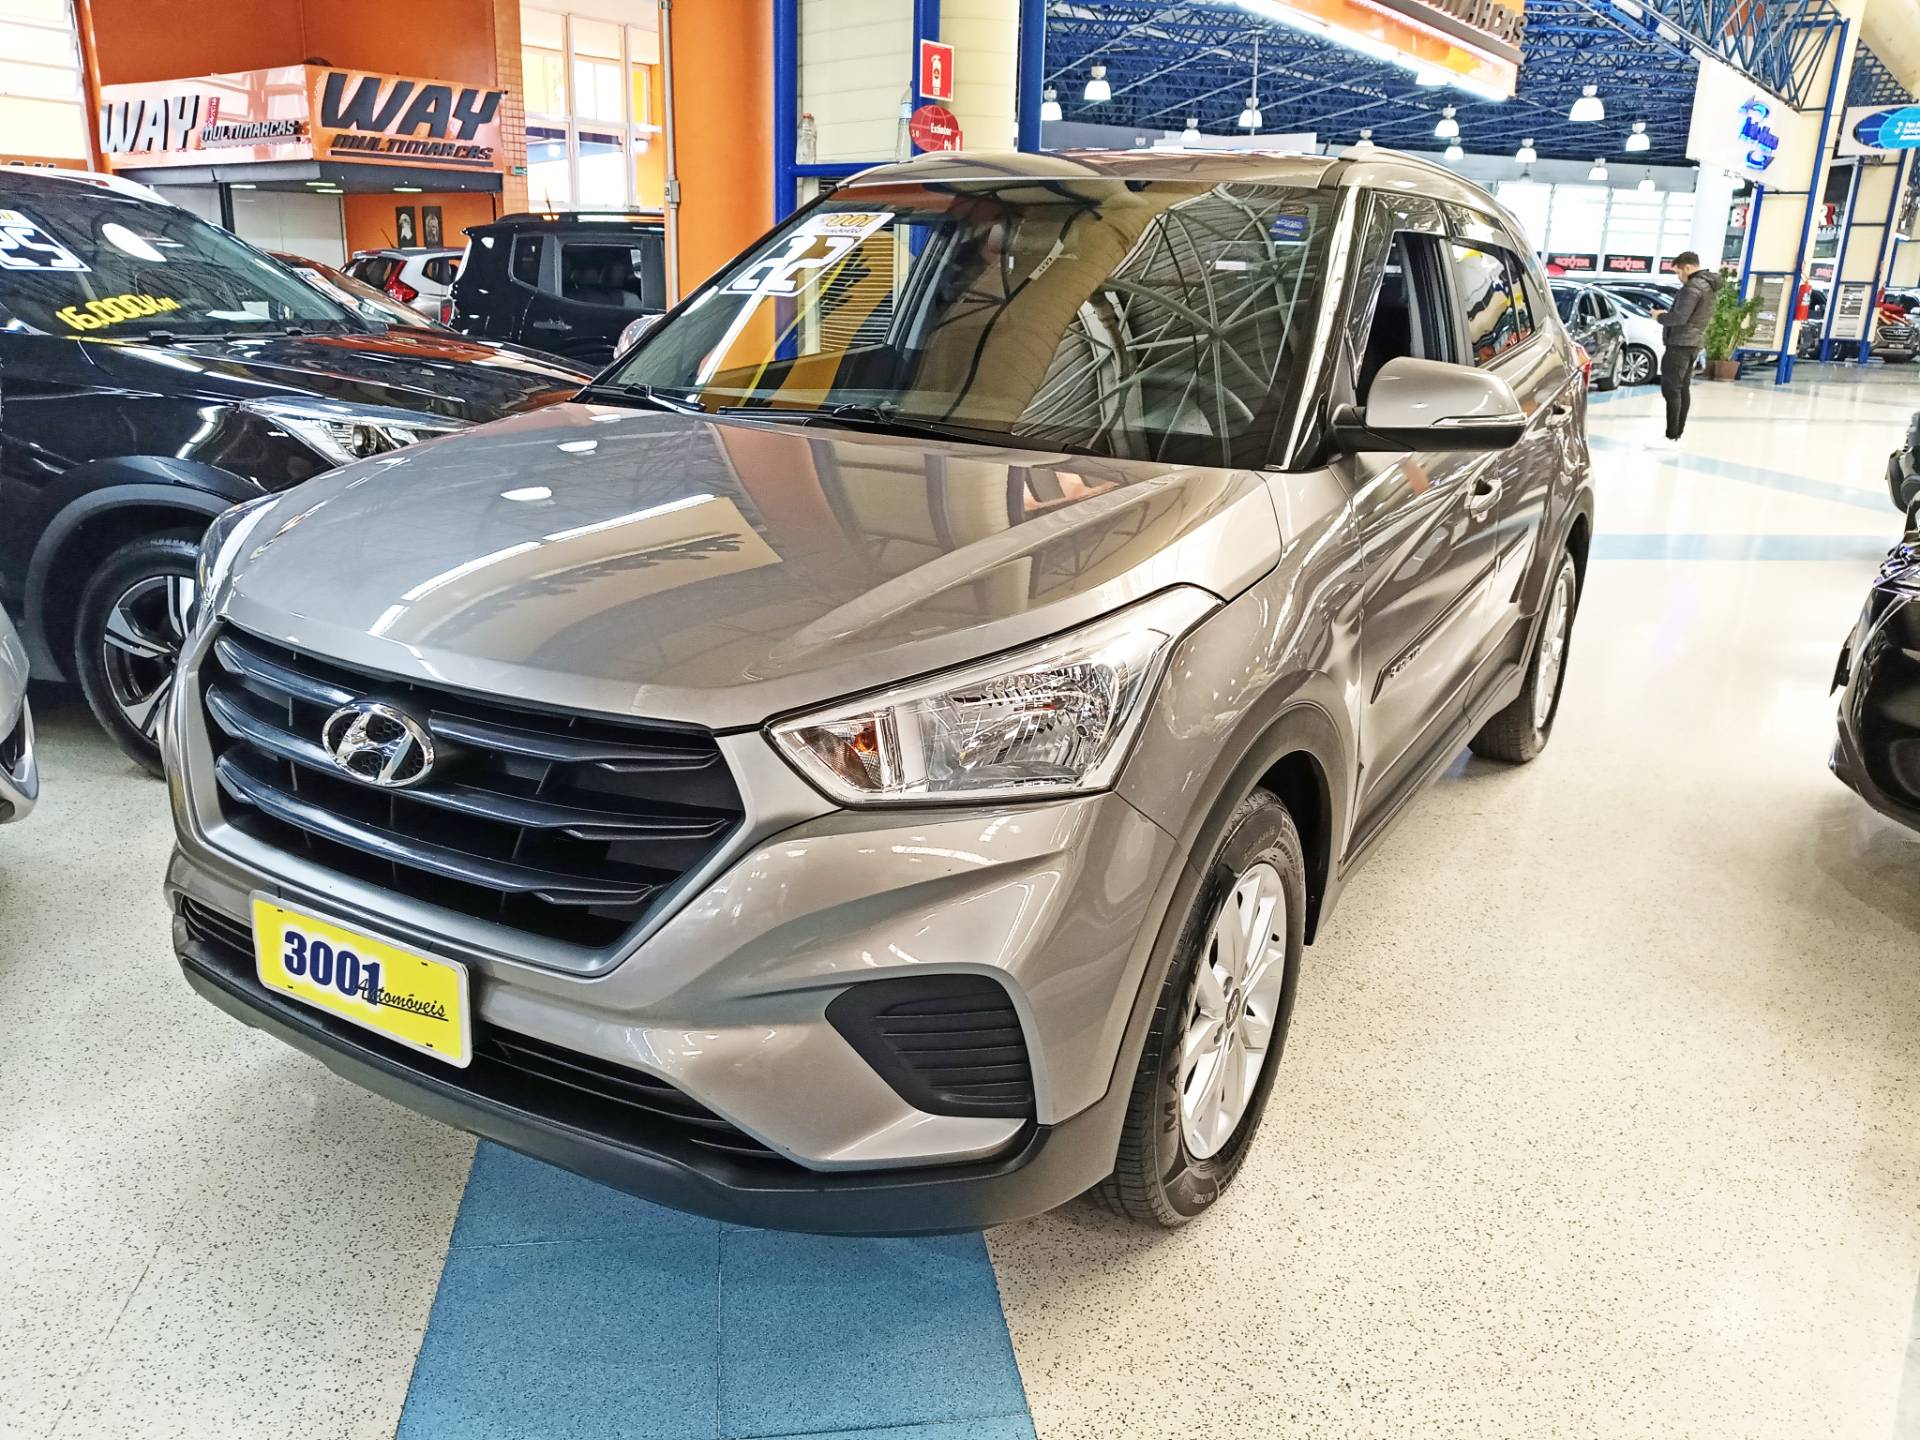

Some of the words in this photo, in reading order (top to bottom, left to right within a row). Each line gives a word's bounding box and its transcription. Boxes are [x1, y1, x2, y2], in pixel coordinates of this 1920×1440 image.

[101, 95, 199, 152] WAY
[203, 120, 299, 141] MULTIMARCAS
[321, 72, 503, 140] WAY
[332, 134, 493, 160] MULTIMARCAS
[732, 237, 854, 291] 22
[285, 931, 380, 1006] 3001
